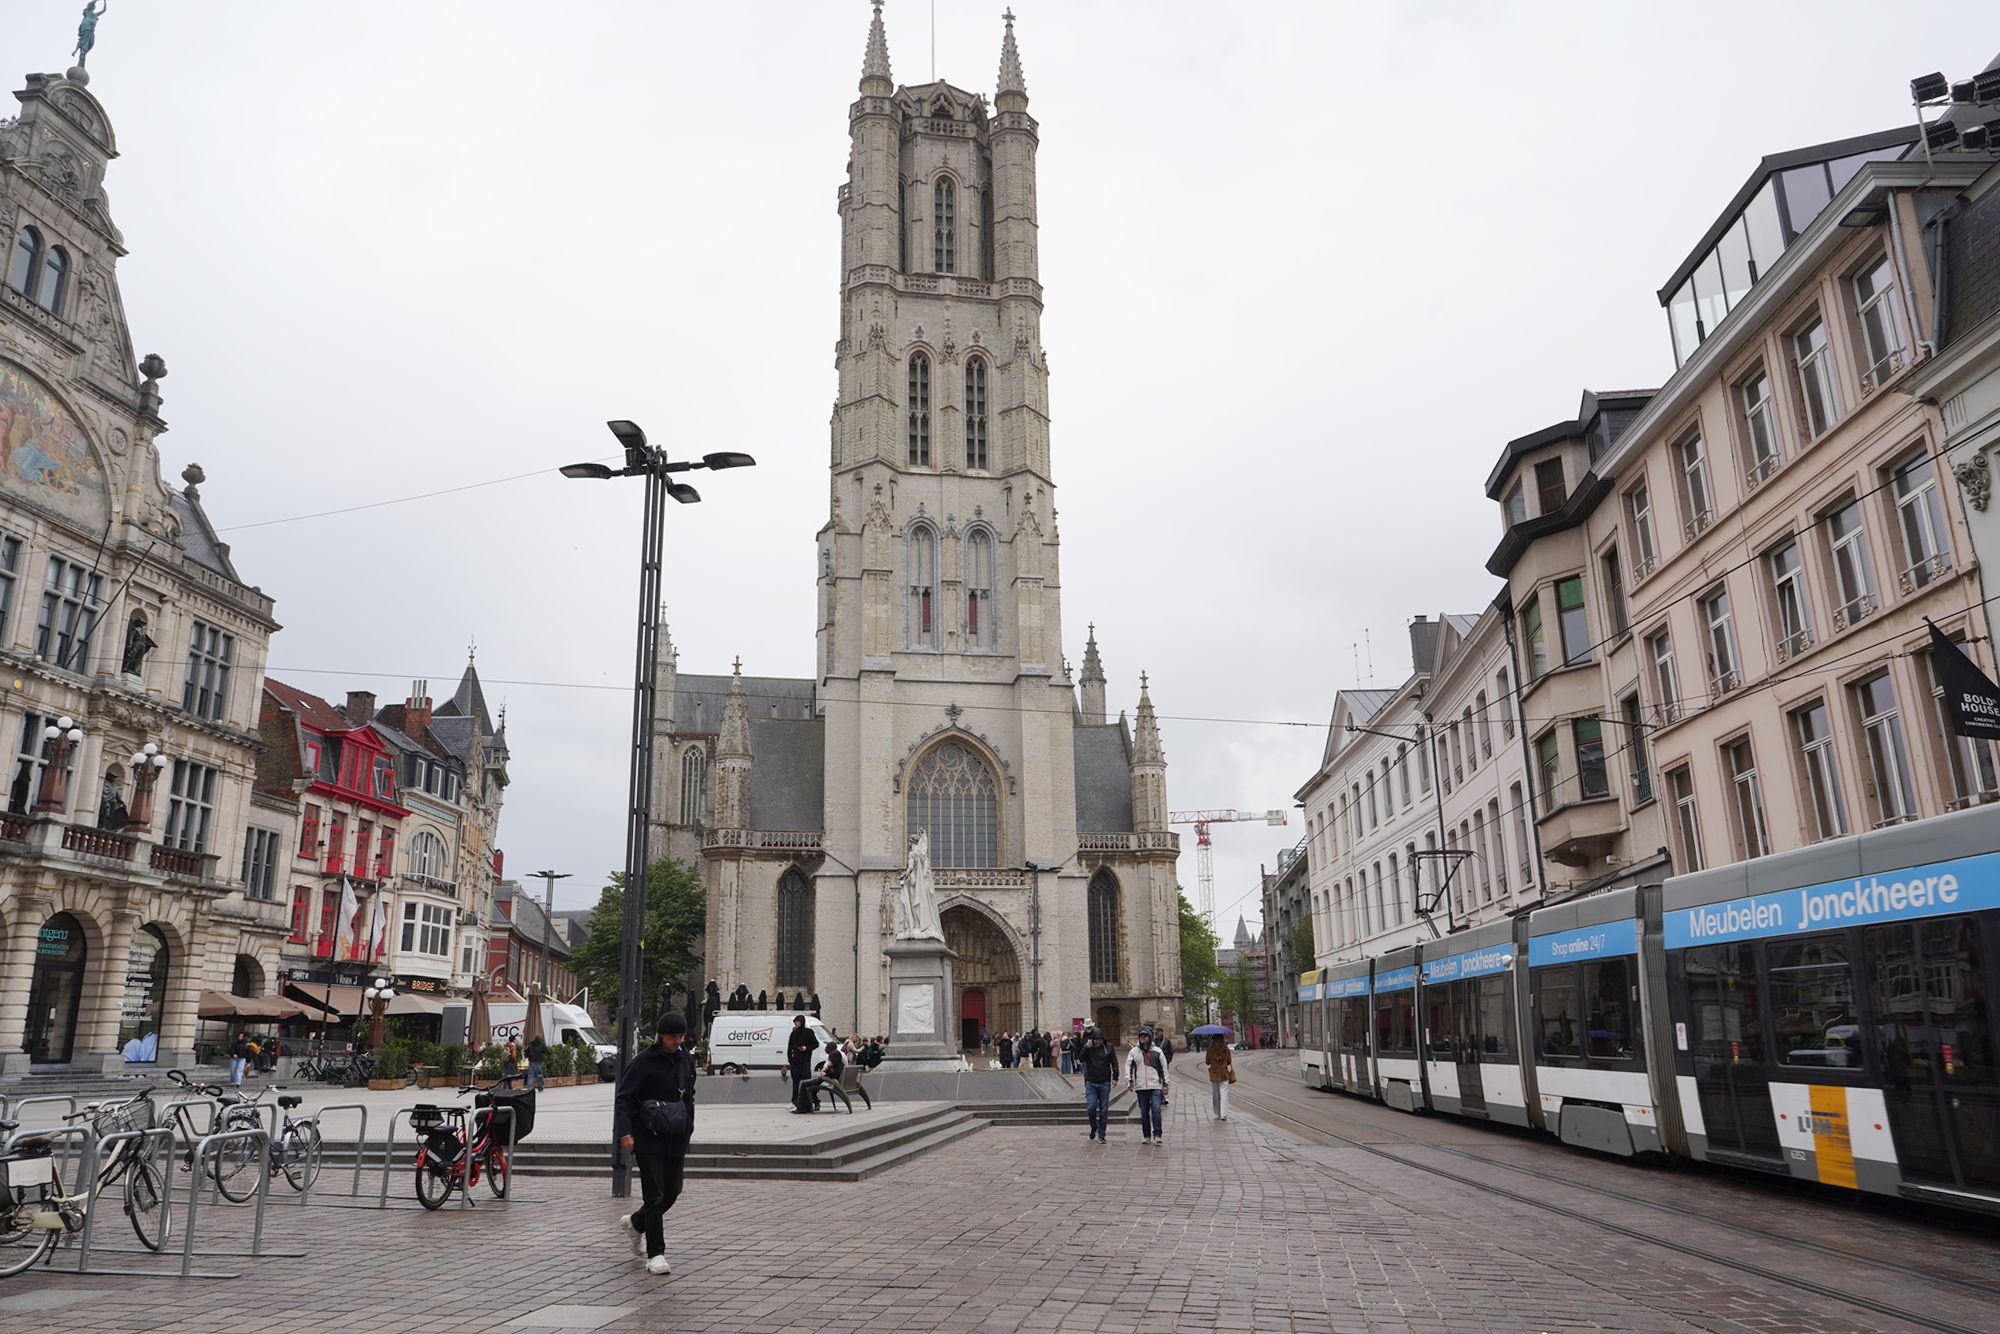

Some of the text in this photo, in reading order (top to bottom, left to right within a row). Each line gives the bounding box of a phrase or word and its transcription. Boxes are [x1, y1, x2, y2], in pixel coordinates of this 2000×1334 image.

[1963, 693, 1993, 706] BOLD
[1960, 702, 2000, 717] HOUSE
[1965, 720, 1993, 728] COWORKING
[1689, 873, 1959, 938] Meubelen Jonckheere
[1552, 934, 1606, 957] Shop online 24/7
[1430, 950, 1500, 978] Meubelen Jonckheere
[411, 980, 434, 991] BRIDGE
[727, 1030, 767, 1041] detrac
